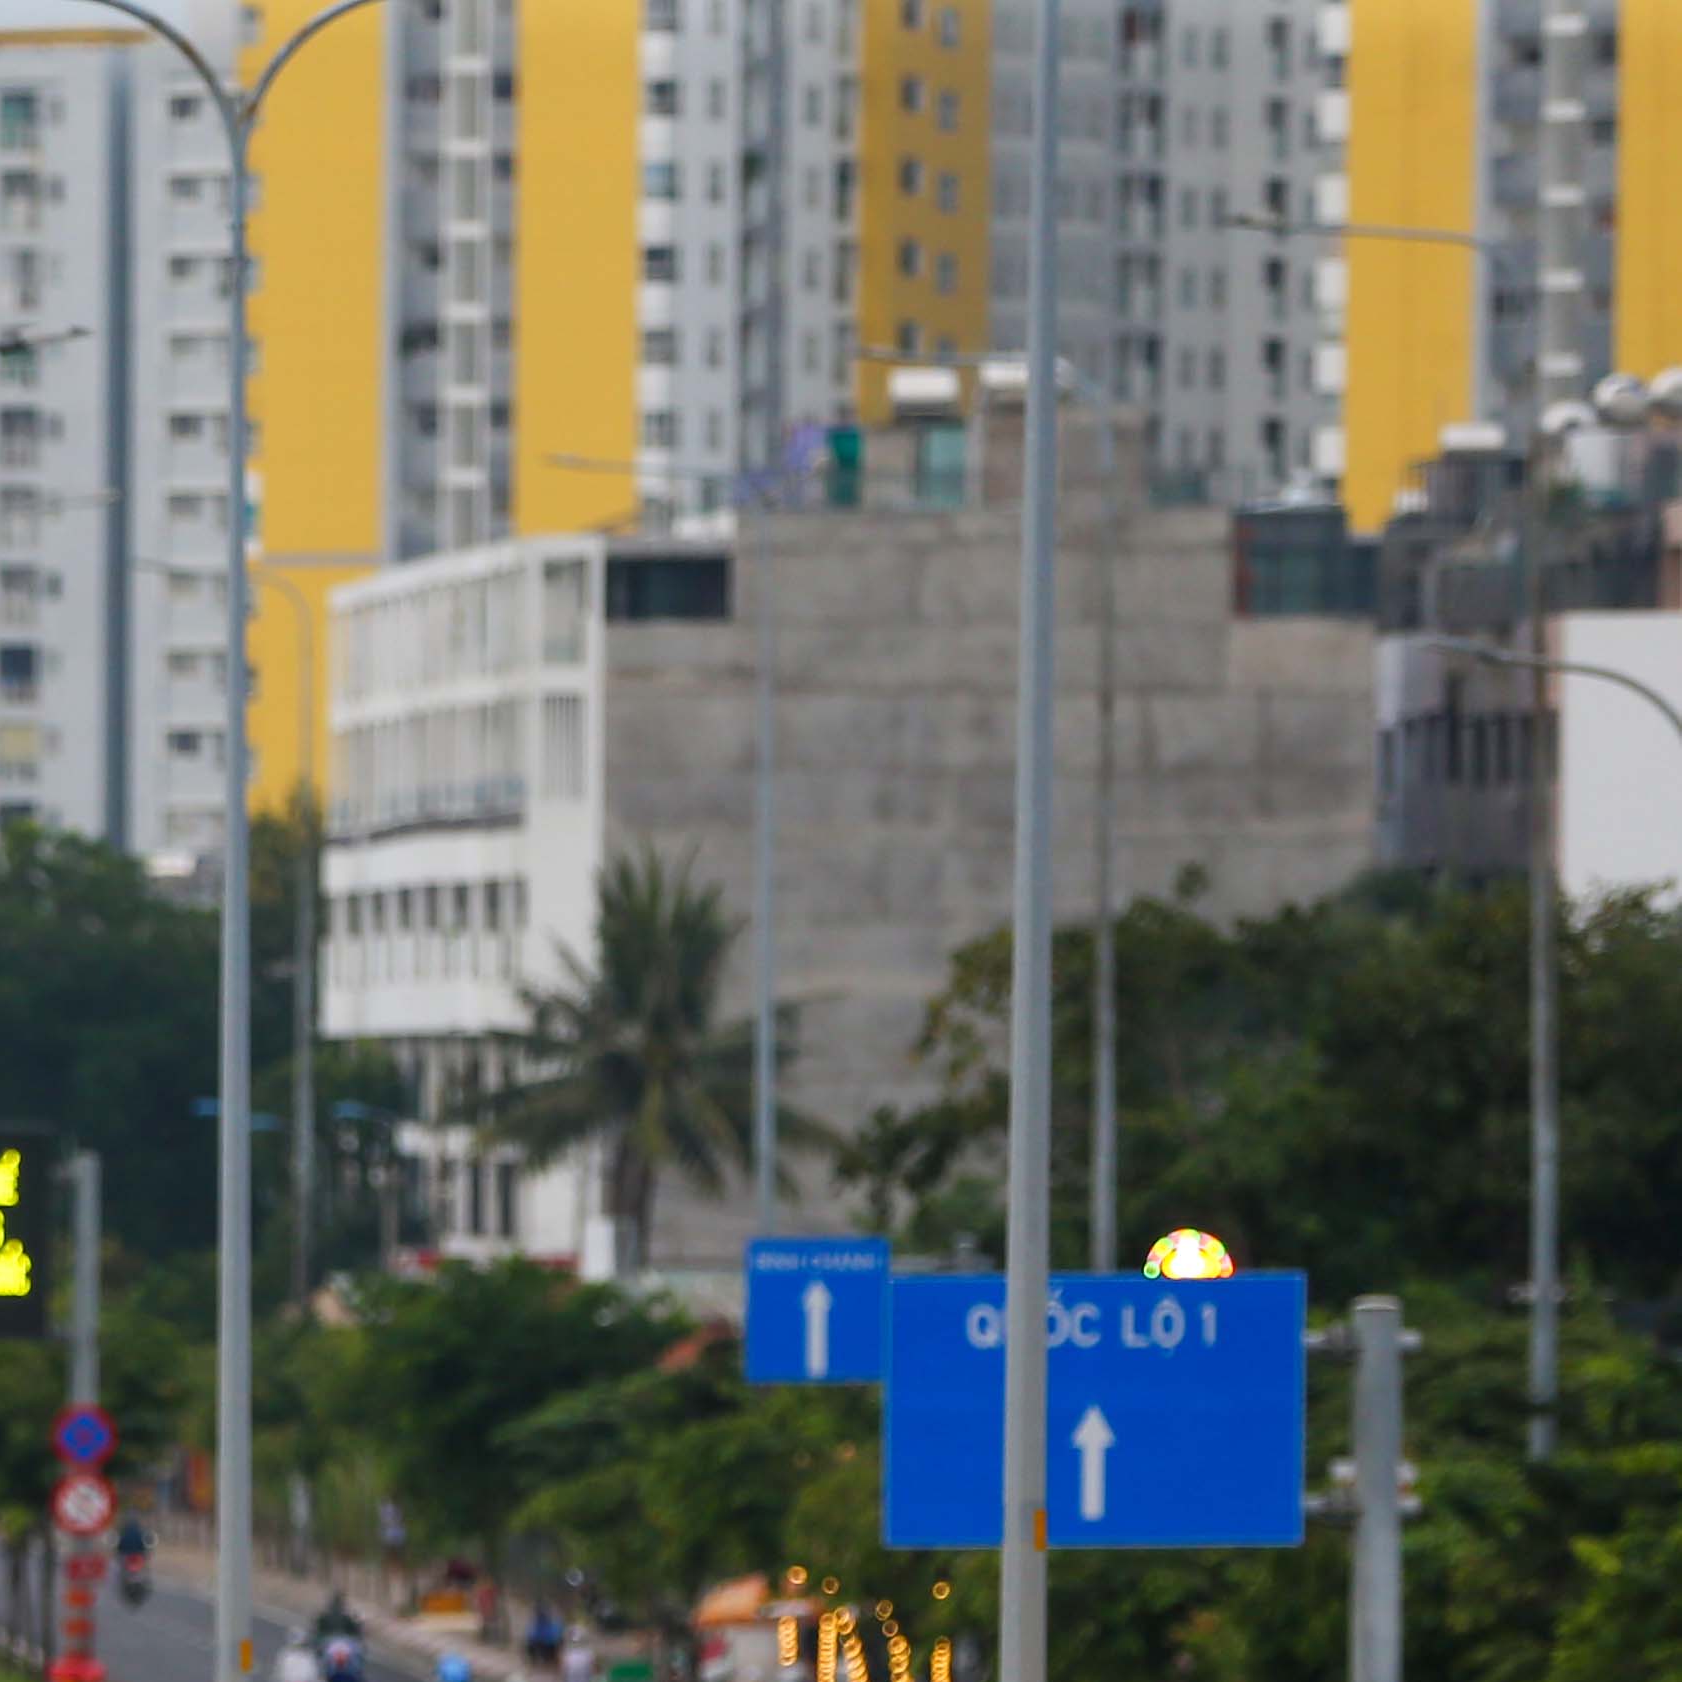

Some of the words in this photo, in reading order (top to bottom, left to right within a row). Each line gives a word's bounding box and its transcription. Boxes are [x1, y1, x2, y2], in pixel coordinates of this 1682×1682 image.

[966, 1288, 1101, 1349] QỐC
[1121, 1293, 1186, 1357] LỘ
[1200, 1302, 1218, 1347] 1
